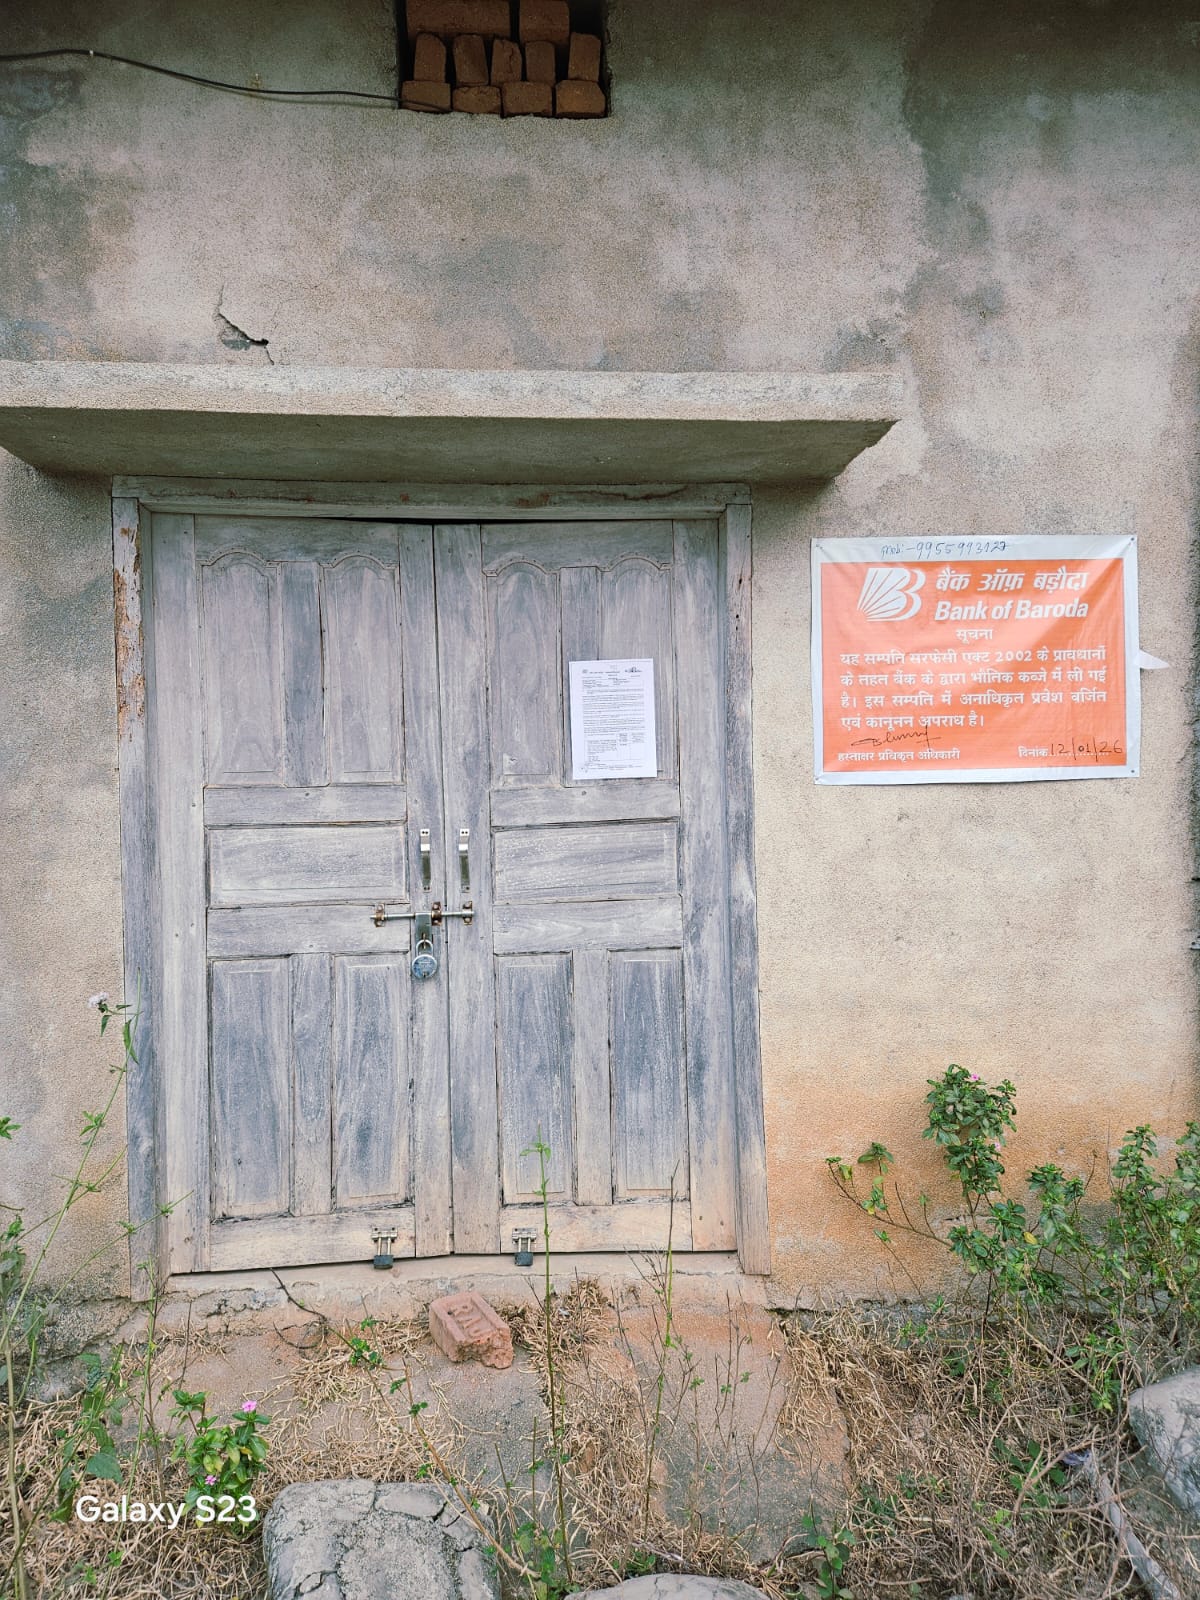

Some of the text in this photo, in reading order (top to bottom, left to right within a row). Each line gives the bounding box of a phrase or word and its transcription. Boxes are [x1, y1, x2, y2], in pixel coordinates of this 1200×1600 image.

[935, 566, 971, 592] बैंक
[1033, 565, 1089, 595] बड़ौदा
[934, 598, 1089, 621] Bank of Baroda
[955, 628, 993, 644] सूचना
[840, 653, 860, 667] यह
[910, 649, 957, 664] सरफेसी
[962, 650, 990, 664] एक्ट
[995, 650, 1032, 662] 2002
[1036, 646, 1049, 661] के
[840, 671, 854, 686] के
[858, 674, 888, 686] तहत
[893, 669, 917, 685] बैंक
[921, 671, 934, 685] के
[939, 673, 966, 686] द्वारा
[971, 668, 1014, 683] भौतिक
[1052, 666, 1062, 682] में
[1067, 667, 1083, 682] ली
[1088, 666, 1107, 683] गई
[865, 695, 885, 710] इस
[941, 690, 951, 705] में
[1031, 689, 1063, 704] प्रवेश
[1071, 687, 1107, 703] वर्जित
[841, 713, 861, 731] एवं
[865, 715, 914, 732] कानूनन
[919, 715, 964, 727] अपराध
[838, 752, 874, 762] हस्ताक्षर
